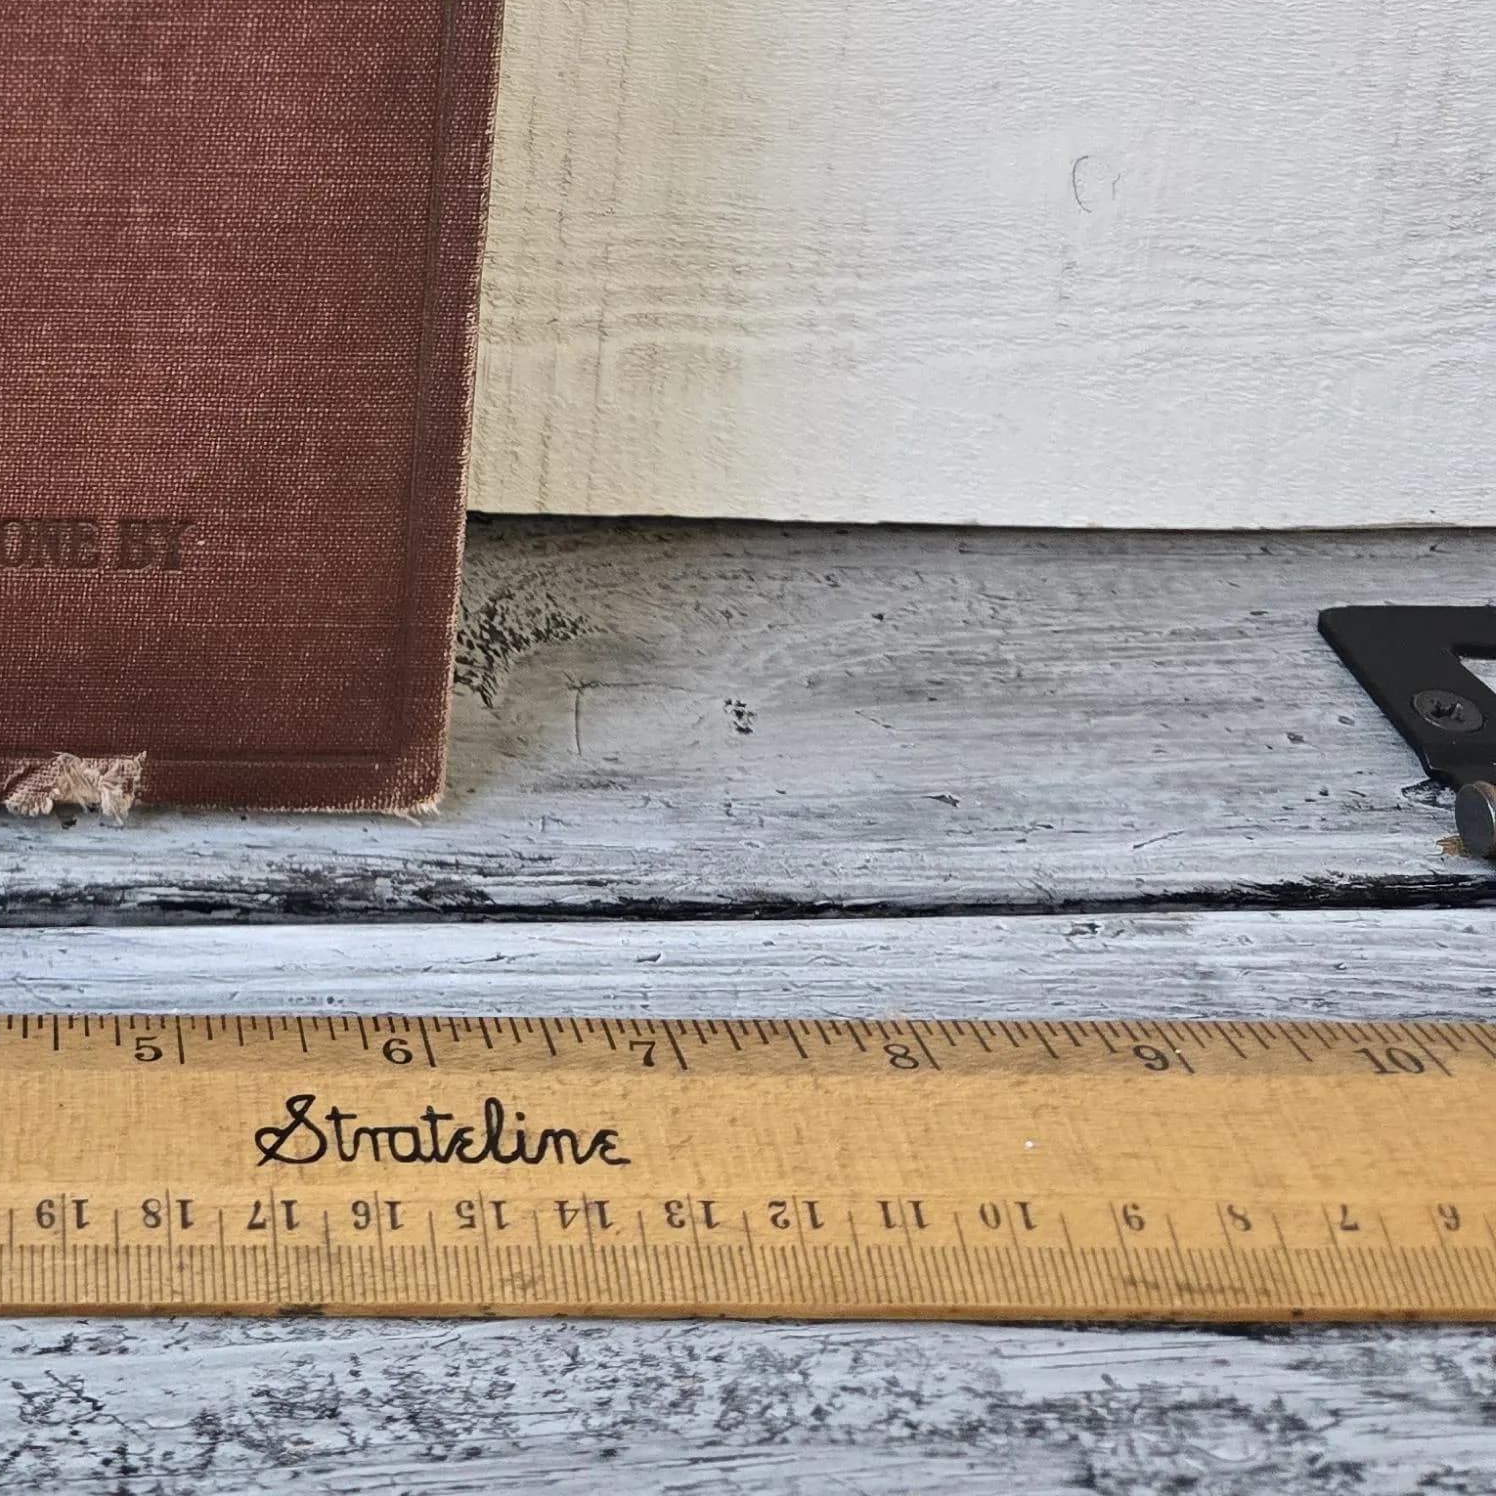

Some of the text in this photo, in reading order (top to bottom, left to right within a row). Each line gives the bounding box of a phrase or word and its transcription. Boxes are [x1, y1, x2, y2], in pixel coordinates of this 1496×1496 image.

[116, 517, 197, 574] BY
[134, 1036, 163, 1063] 5
[383, 1038, 413, 1065] 6
[629, 1041, 656, 1068] 7
[883, 1043, 919, 1070] 8
[1132, 1045, 1169, 1071] 9
[1354, 1047, 1425, 1074] 10
[254, 1094, 631, 1166] Strateline
[35, 1197, 91, 1229] 19
[141, 1197, 195, 1229] 18
[247, 1200, 302, 1229] 17
[351, 1200, 405, 1229] 16
[455, 1200, 510, 1229] 15
[553, 1200, 614, 1229] 14
[664, 1200, 720, 1229] 13
[768, 1201, 825, 1231] 12
[876, 1201, 930, 1231] 11
[979, 1201, 1038, 1231] 10
[1226, 1203, 1252, 1232] 8
[1339, 1203, 1360, 1232] 7
